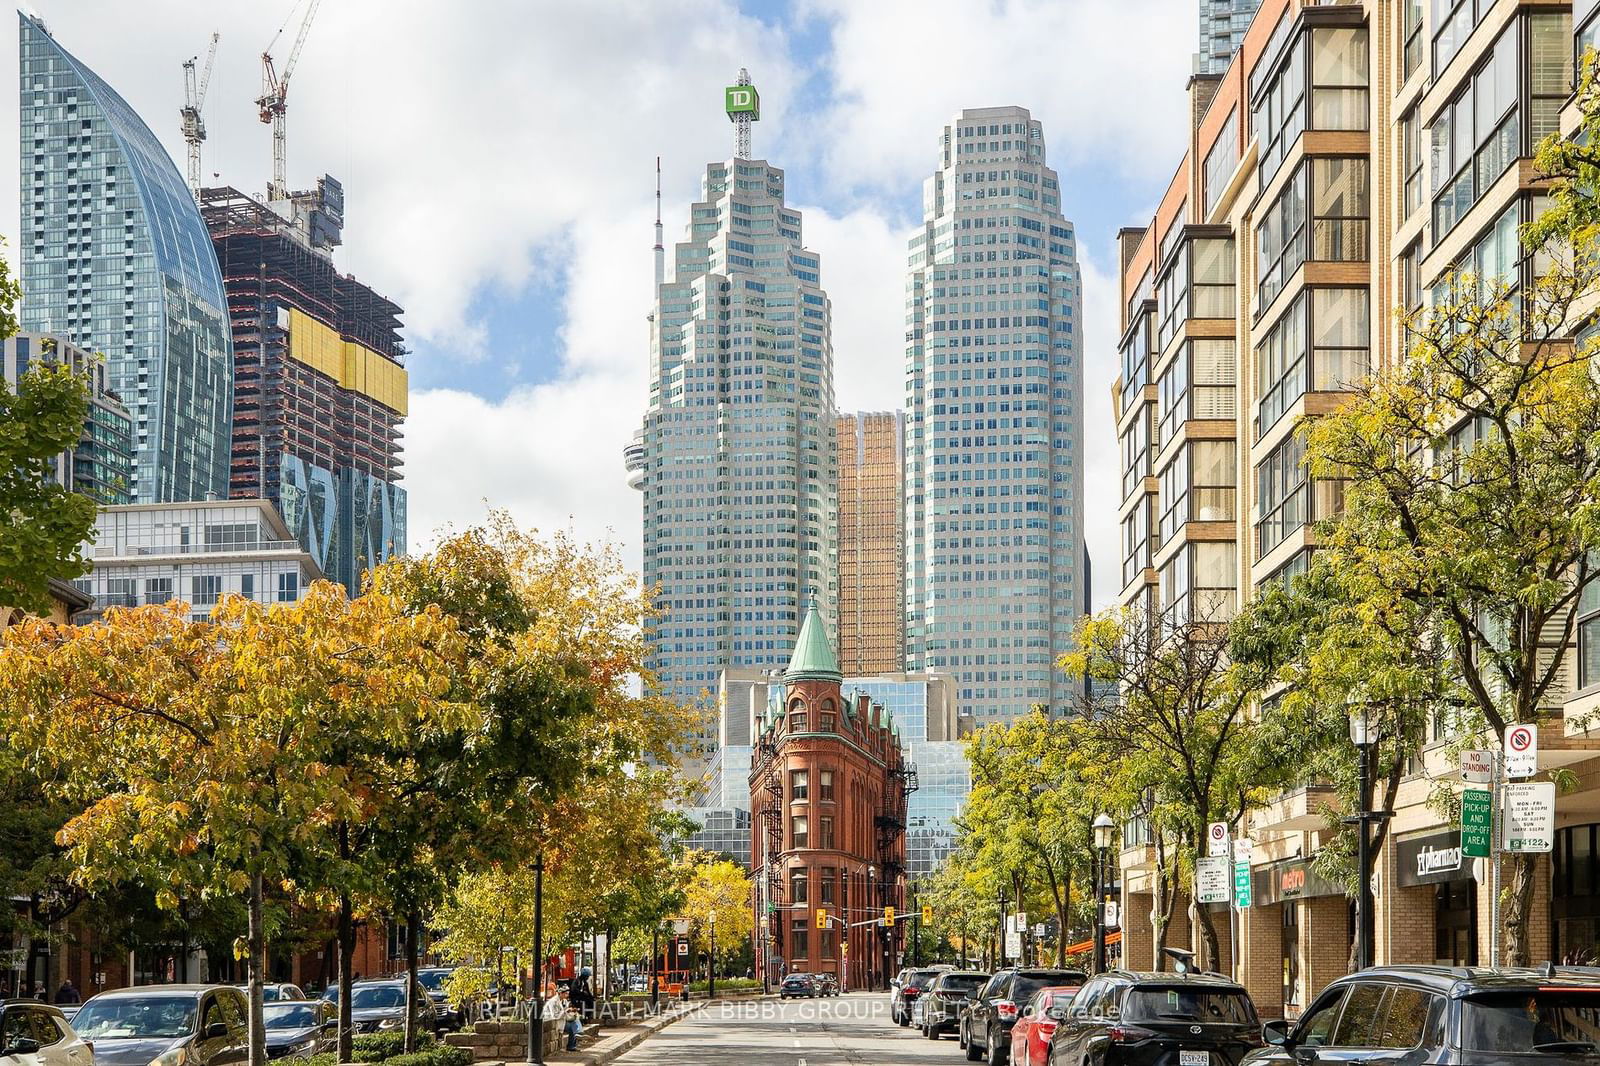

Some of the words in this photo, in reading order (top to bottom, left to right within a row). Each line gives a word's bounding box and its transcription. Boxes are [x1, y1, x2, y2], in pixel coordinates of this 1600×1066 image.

[729, 91, 750, 106] TD
[1470, 753, 1480, 762] NO
[1462, 763, 1490, 773] STANDING
[1464, 792, 1490, 801] PASSENGER
[1464, 803, 1490, 813] PICK-UP
[1470, 815, 1484, 824] AND
[1463, 825, 1490, 834] DROP-OFF
[1467, 836, 1486, 845] AREA
